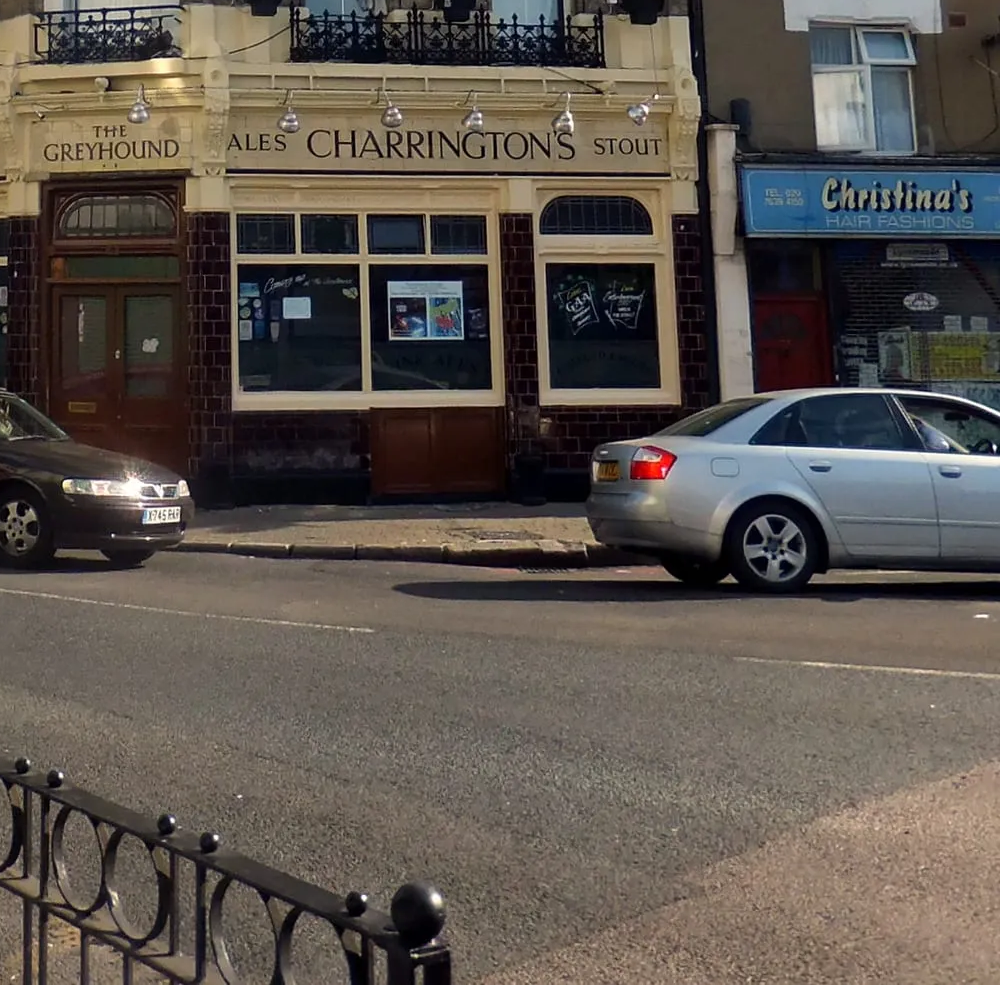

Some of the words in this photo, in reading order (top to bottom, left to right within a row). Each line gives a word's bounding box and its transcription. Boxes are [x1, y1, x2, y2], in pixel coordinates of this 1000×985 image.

[92, 125, 127, 139] THE
[43, 139, 180, 162] GREYHOUND
[227, 133, 287, 153] ALES
[306, 129, 576, 161] CHARRINGTON'S
[593, 137, 663, 156] STOUT
[821, 177, 973, 214] Christina's
[826, 215, 871, 228] HAIR
[878, 215, 975, 229] FASHIONS
